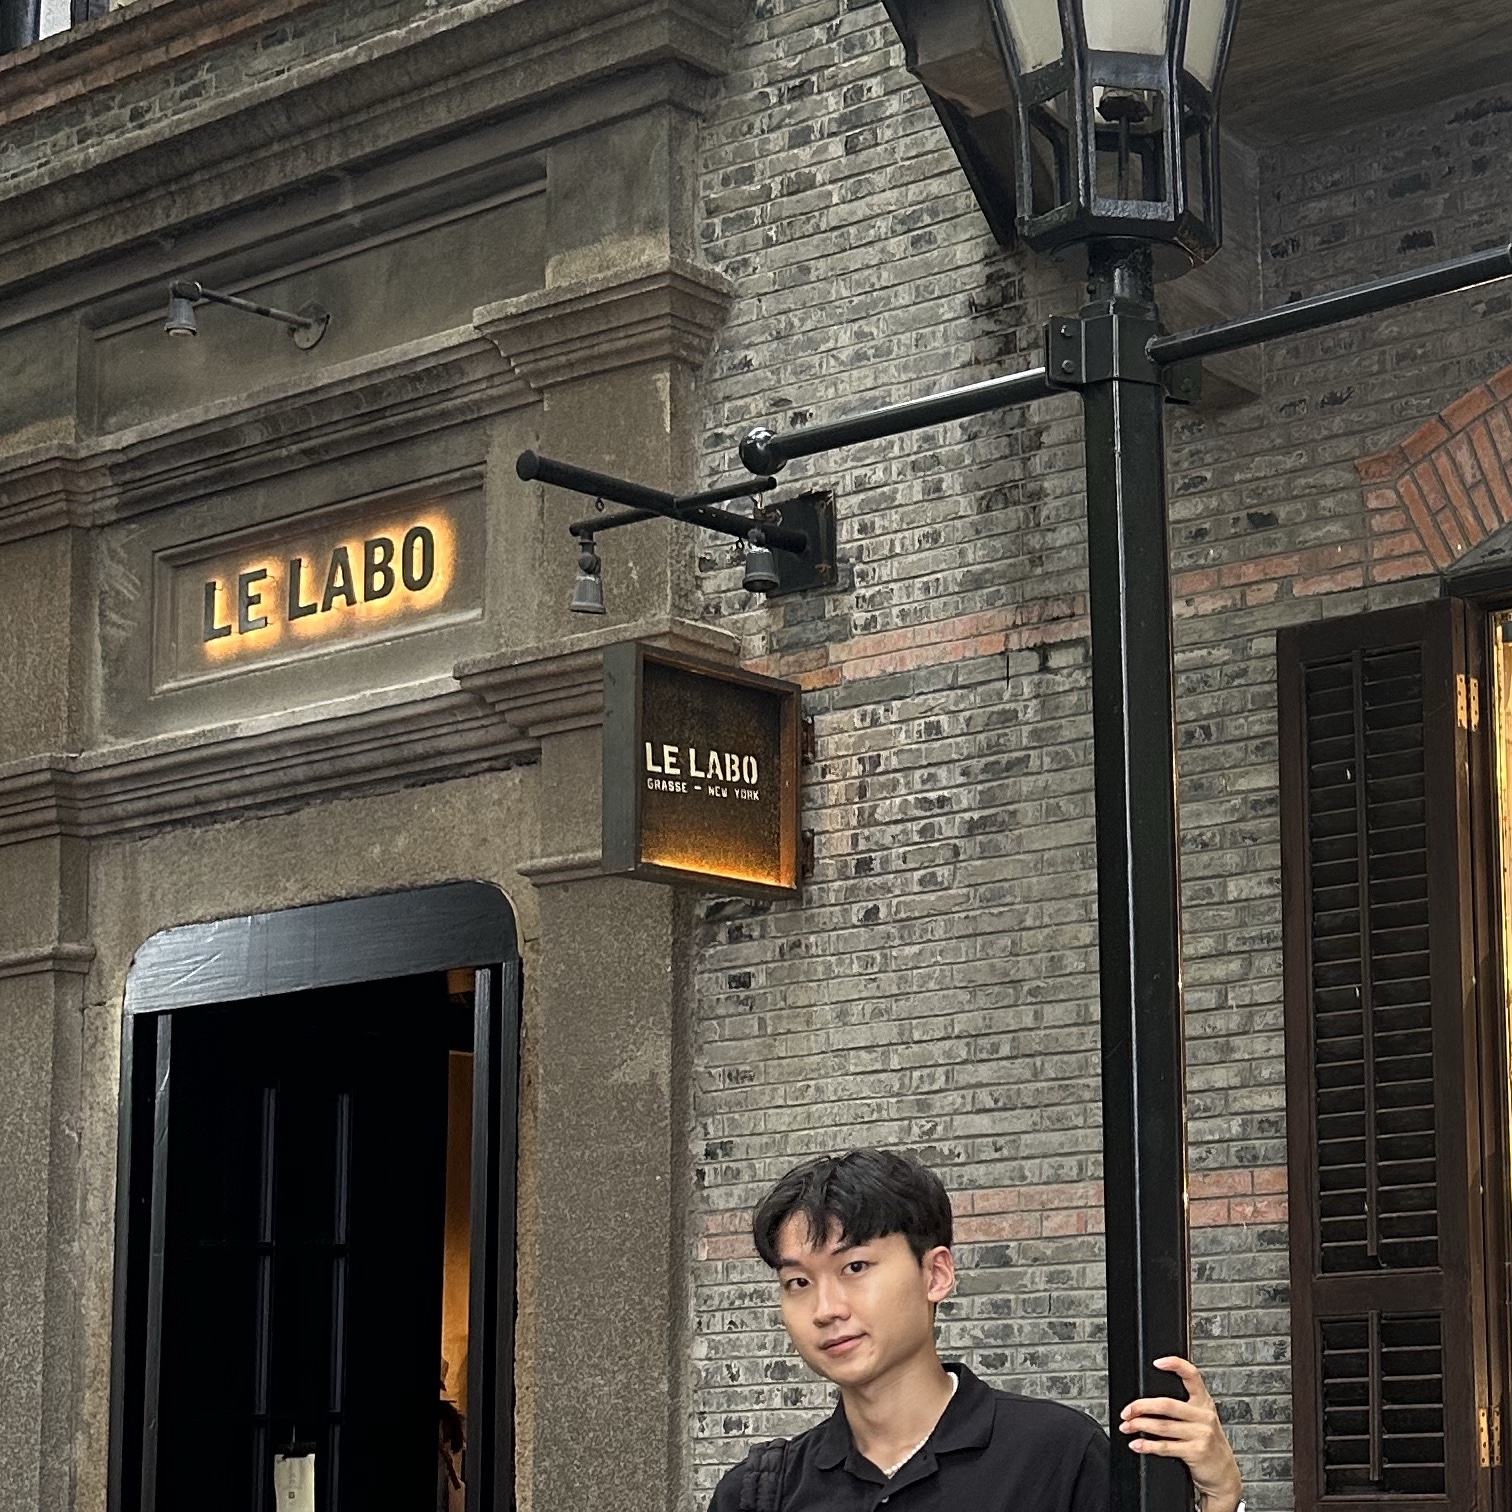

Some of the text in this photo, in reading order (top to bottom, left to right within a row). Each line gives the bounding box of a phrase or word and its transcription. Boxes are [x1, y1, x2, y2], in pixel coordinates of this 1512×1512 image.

[203, 526, 435, 642] LE LABO
[645, 741, 759, 785] LE LABO
[646, 777, 688, 794] GRASSE
[707, 785, 728, 798] NEW
[733, 787, 760, 801] YORK
